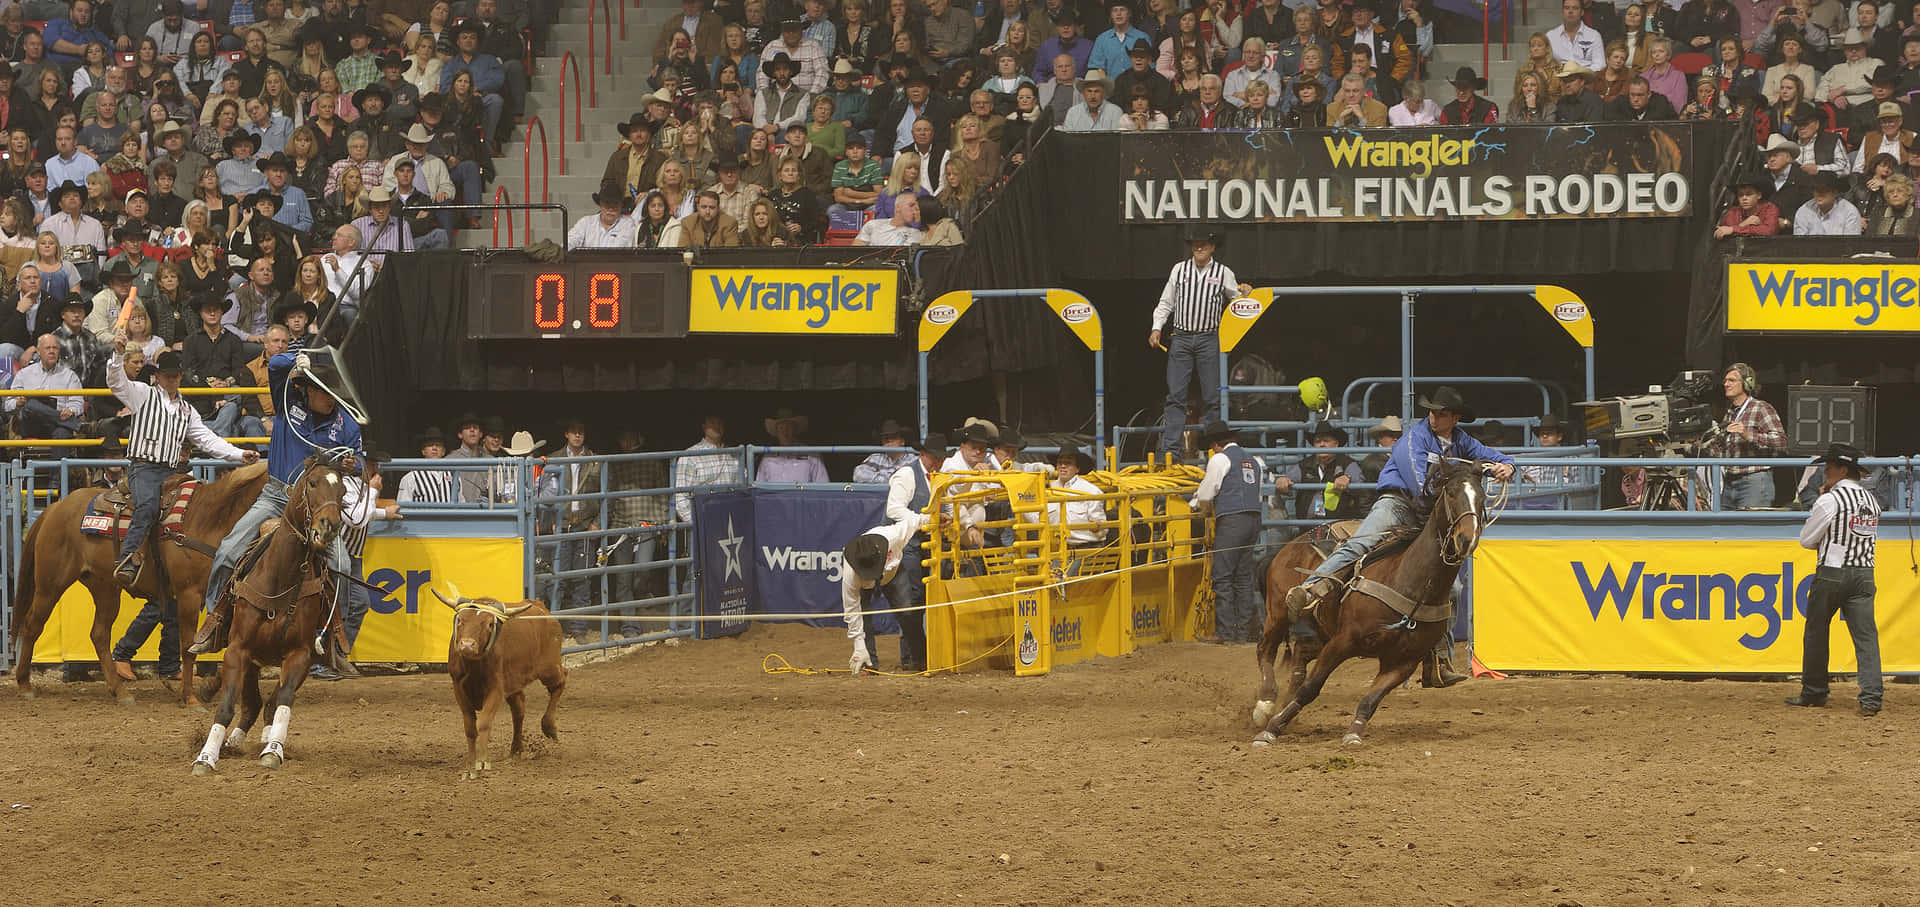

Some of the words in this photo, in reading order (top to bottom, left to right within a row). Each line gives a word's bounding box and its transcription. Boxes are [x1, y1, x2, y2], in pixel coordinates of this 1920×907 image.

[1323, 135, 1476, 179] Wrangler
[1124, 177, 1344, 220] NATIONAL
[1353, 175, 1514, 218] FINALS
[1525, 172, 1690, 216] RODEO
[709, 274, 881, 329] Wrangler
[1232, 303, 1260, 313] prca
[1747, 269, 1920, 326] Wrangle
[762, 545, 844, 583] Wrang
[1018, 599, 1038, 617] NFR
[1132, 603, 1161, 631] iefert
[1570, 561, 1818, 651] Wrangl
[1050, 616, 1082, 645] riefert
